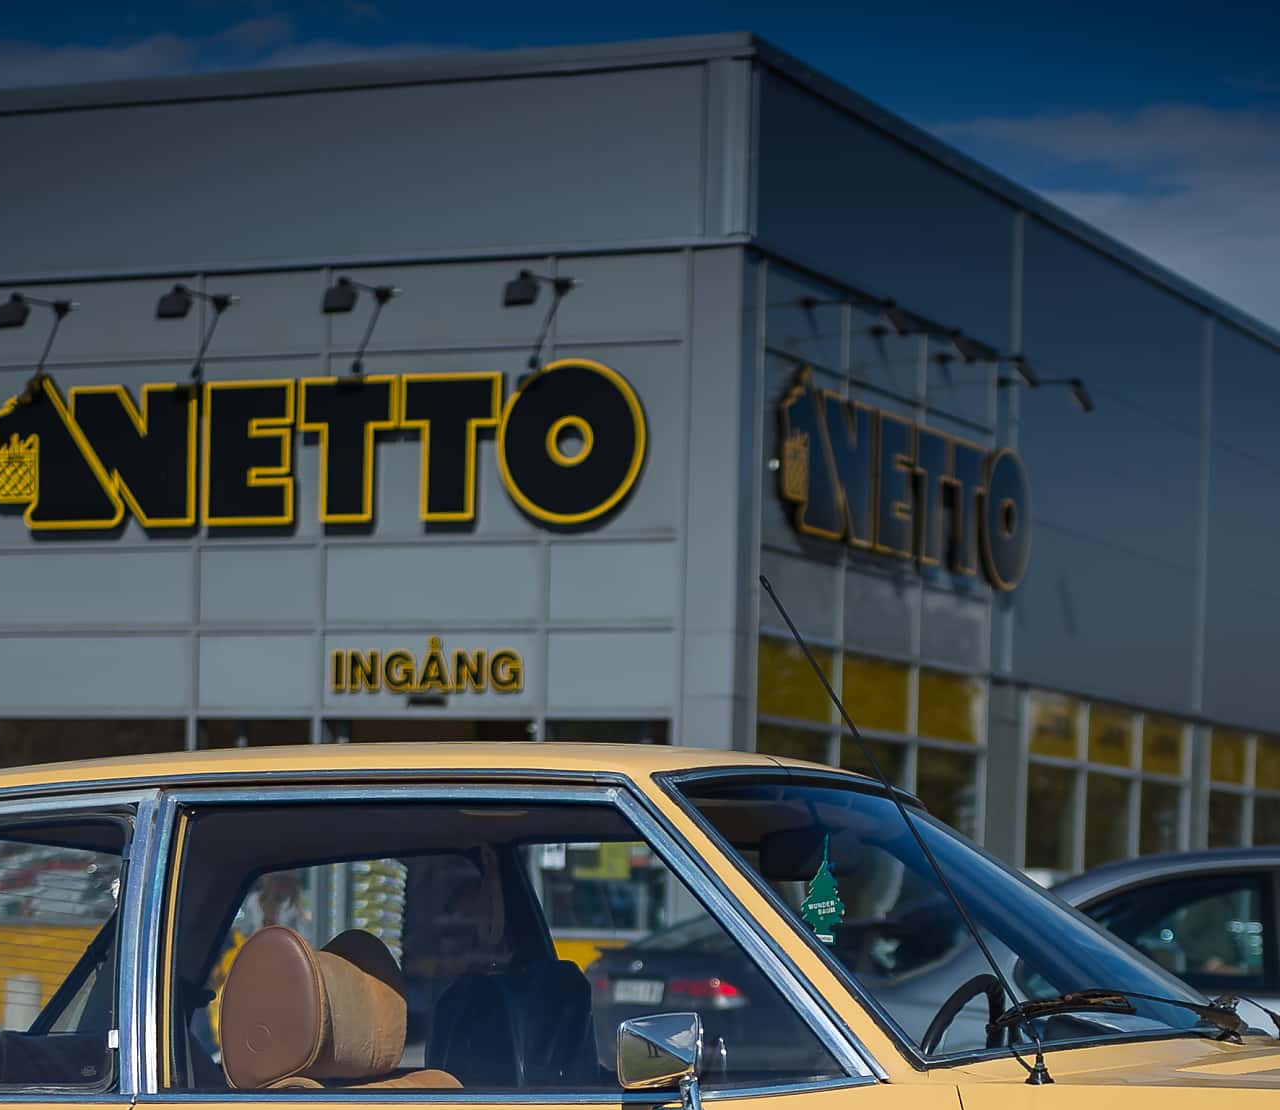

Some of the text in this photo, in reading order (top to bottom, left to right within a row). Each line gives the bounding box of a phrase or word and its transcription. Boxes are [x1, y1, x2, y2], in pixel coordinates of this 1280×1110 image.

[779, 364, 1032, 592] NETTO
[330, 637, 522, 694] INGÅNG
[818, 906, 836, 915] BAUM
